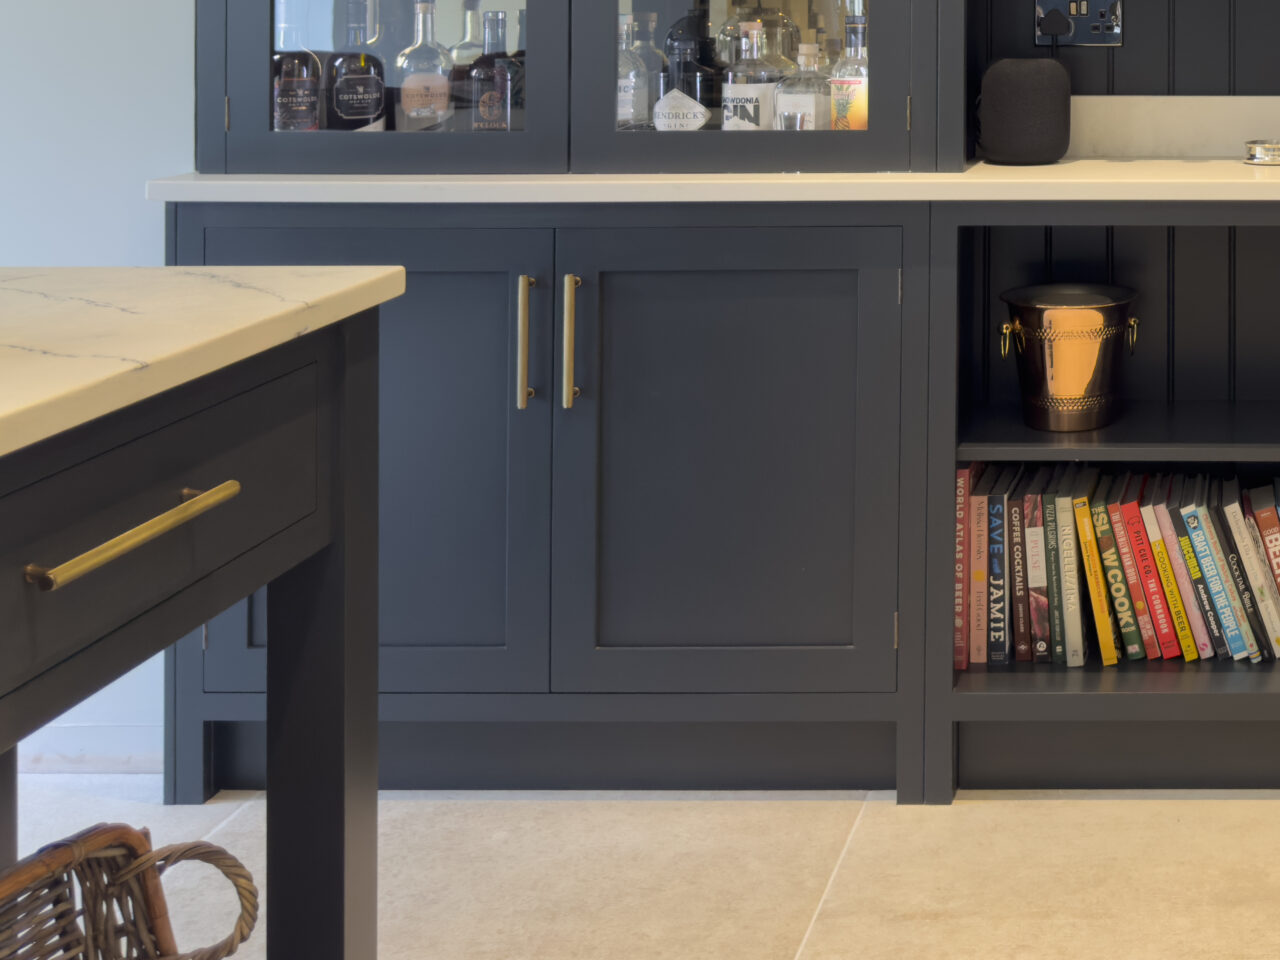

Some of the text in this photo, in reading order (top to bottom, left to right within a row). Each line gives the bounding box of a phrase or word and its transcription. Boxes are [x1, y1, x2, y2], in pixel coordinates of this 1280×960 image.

[955, 477, 965, 612] WORLD ATLAS OF BEER
[989, 504, 1003, 554] SAVE
[1046, 504, 1055, 520] PIZZA
[1011, 507, 1024, 596] COFFEE COCKTAILS
[1133, 530, 1143, 546] PITT
[1138, 549, 1148, 562] CUE
[1147, 578, 1157, 593] THE
[1152, 595, 1169, 634] COOKBOOK
[1191, 530, 1239, 638] CRAFT BEER FOR THE PEOPLE
[990, 575, 1004, 641] JAMIE
[1108, 569, 1134, 627] COOK
[1157, 551, 1186, 633] COOKING WITH BEER
[1197, 584, 1211, 610] Andrew
[1206, 611, 1220, 637] Cooper
